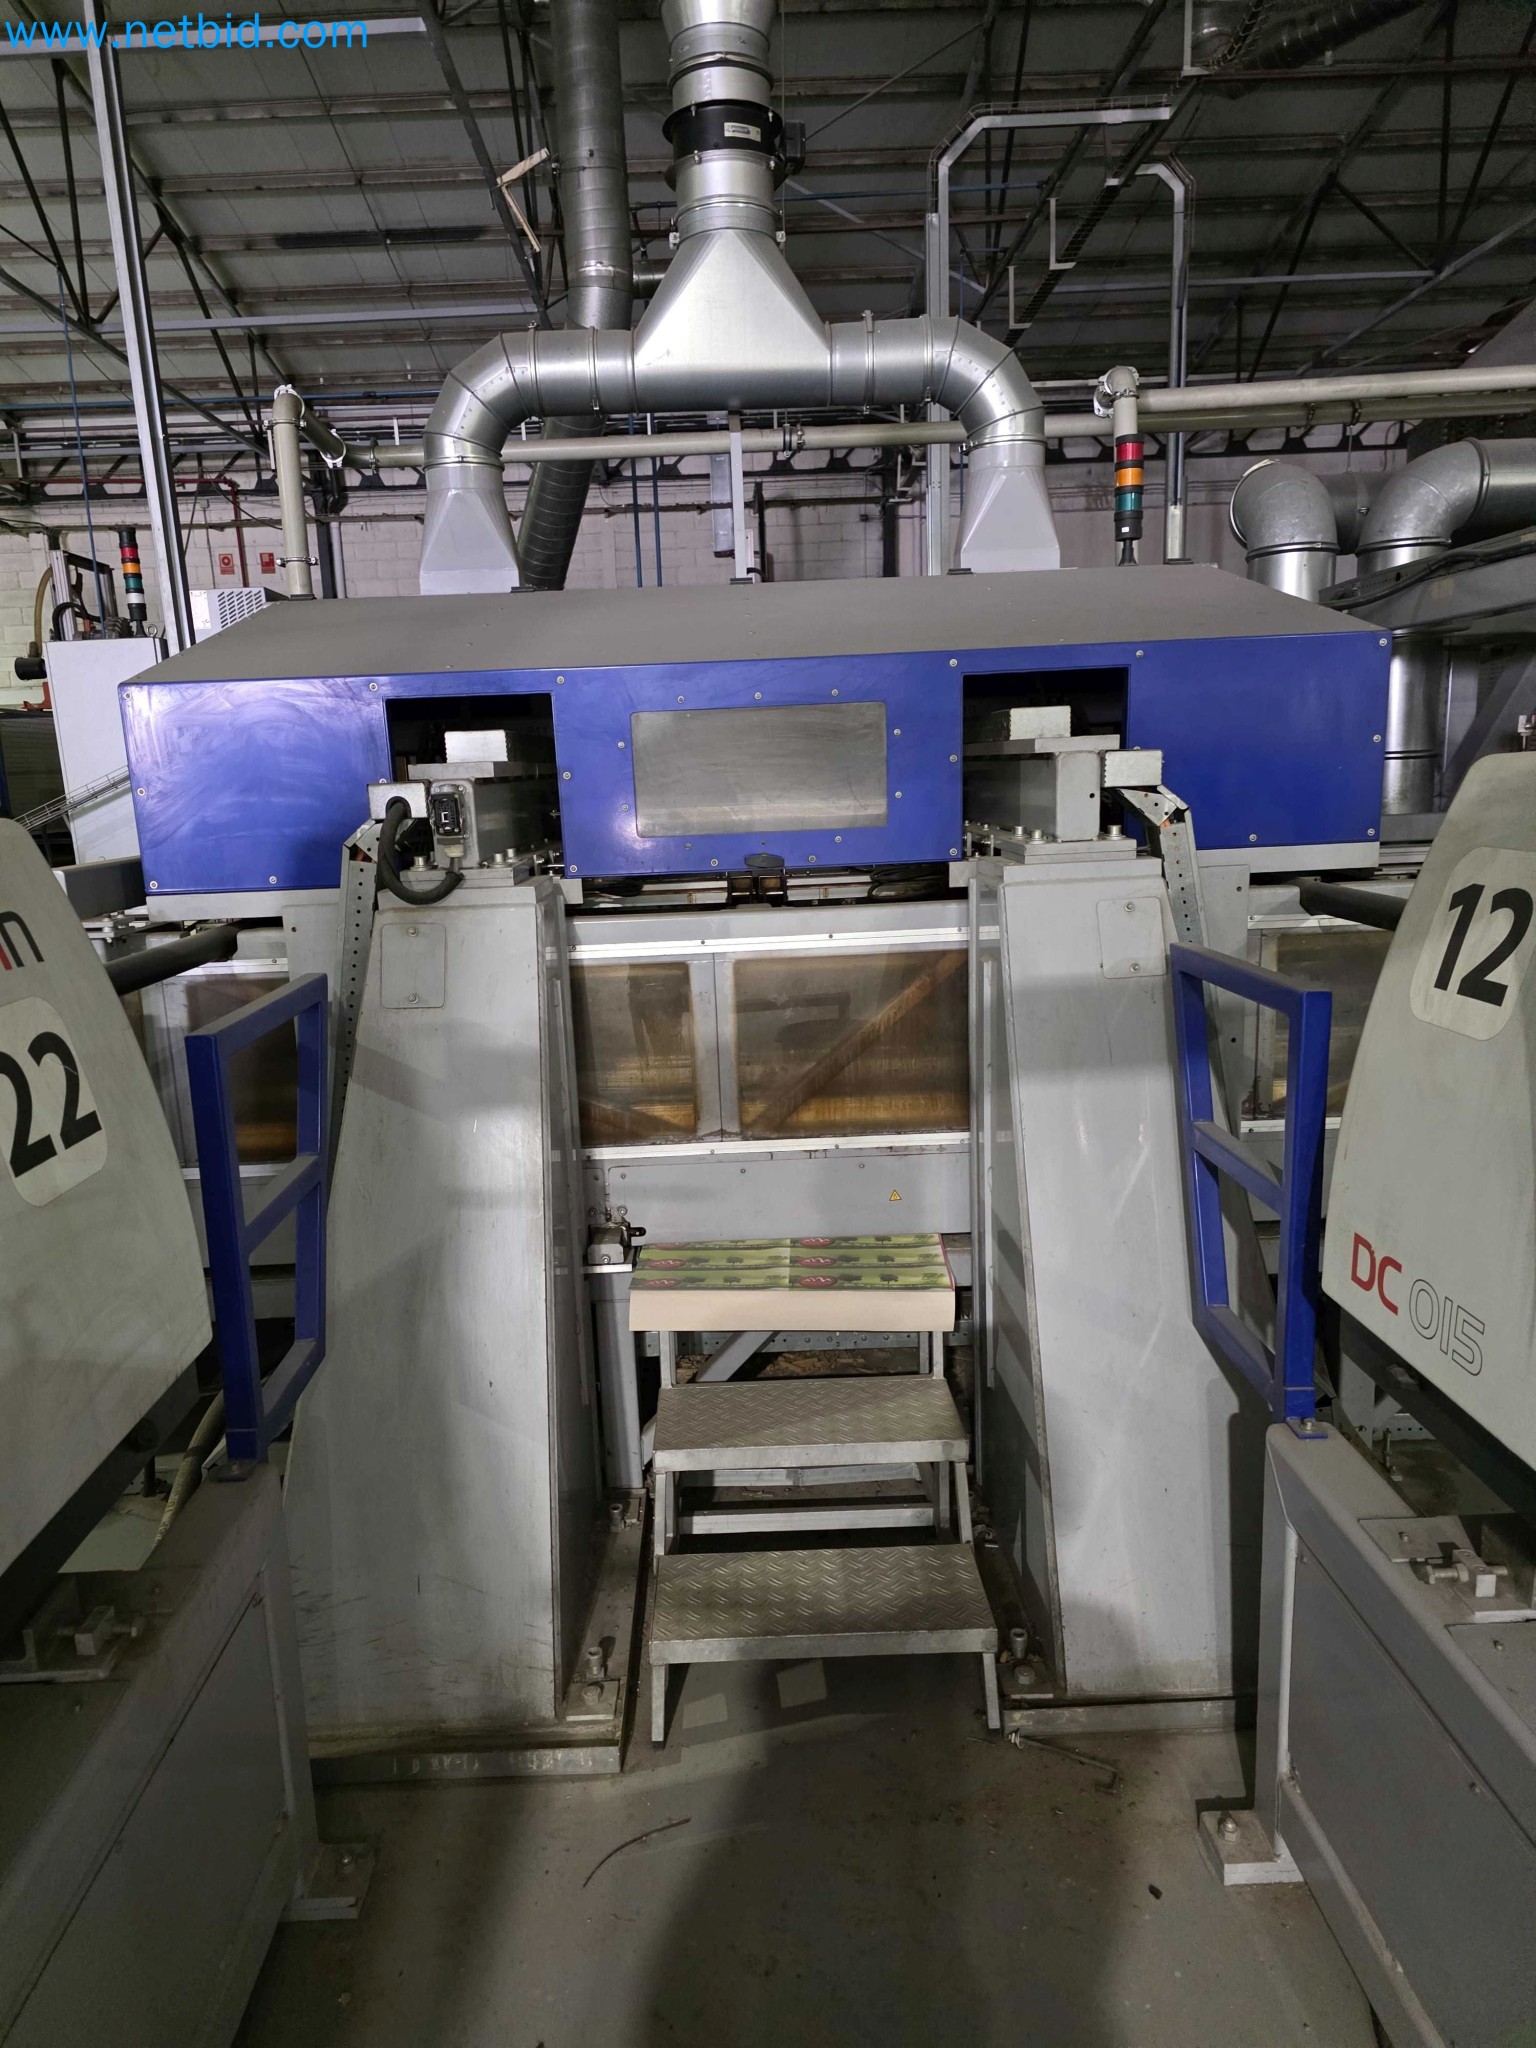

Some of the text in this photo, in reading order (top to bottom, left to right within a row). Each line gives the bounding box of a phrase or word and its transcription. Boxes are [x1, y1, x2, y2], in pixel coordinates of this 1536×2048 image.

[1434, 883, 1534, 1007] 12
[0, 1031, 102, 1178] 22
[1351, 1232, 1486, 1377] DC 015
